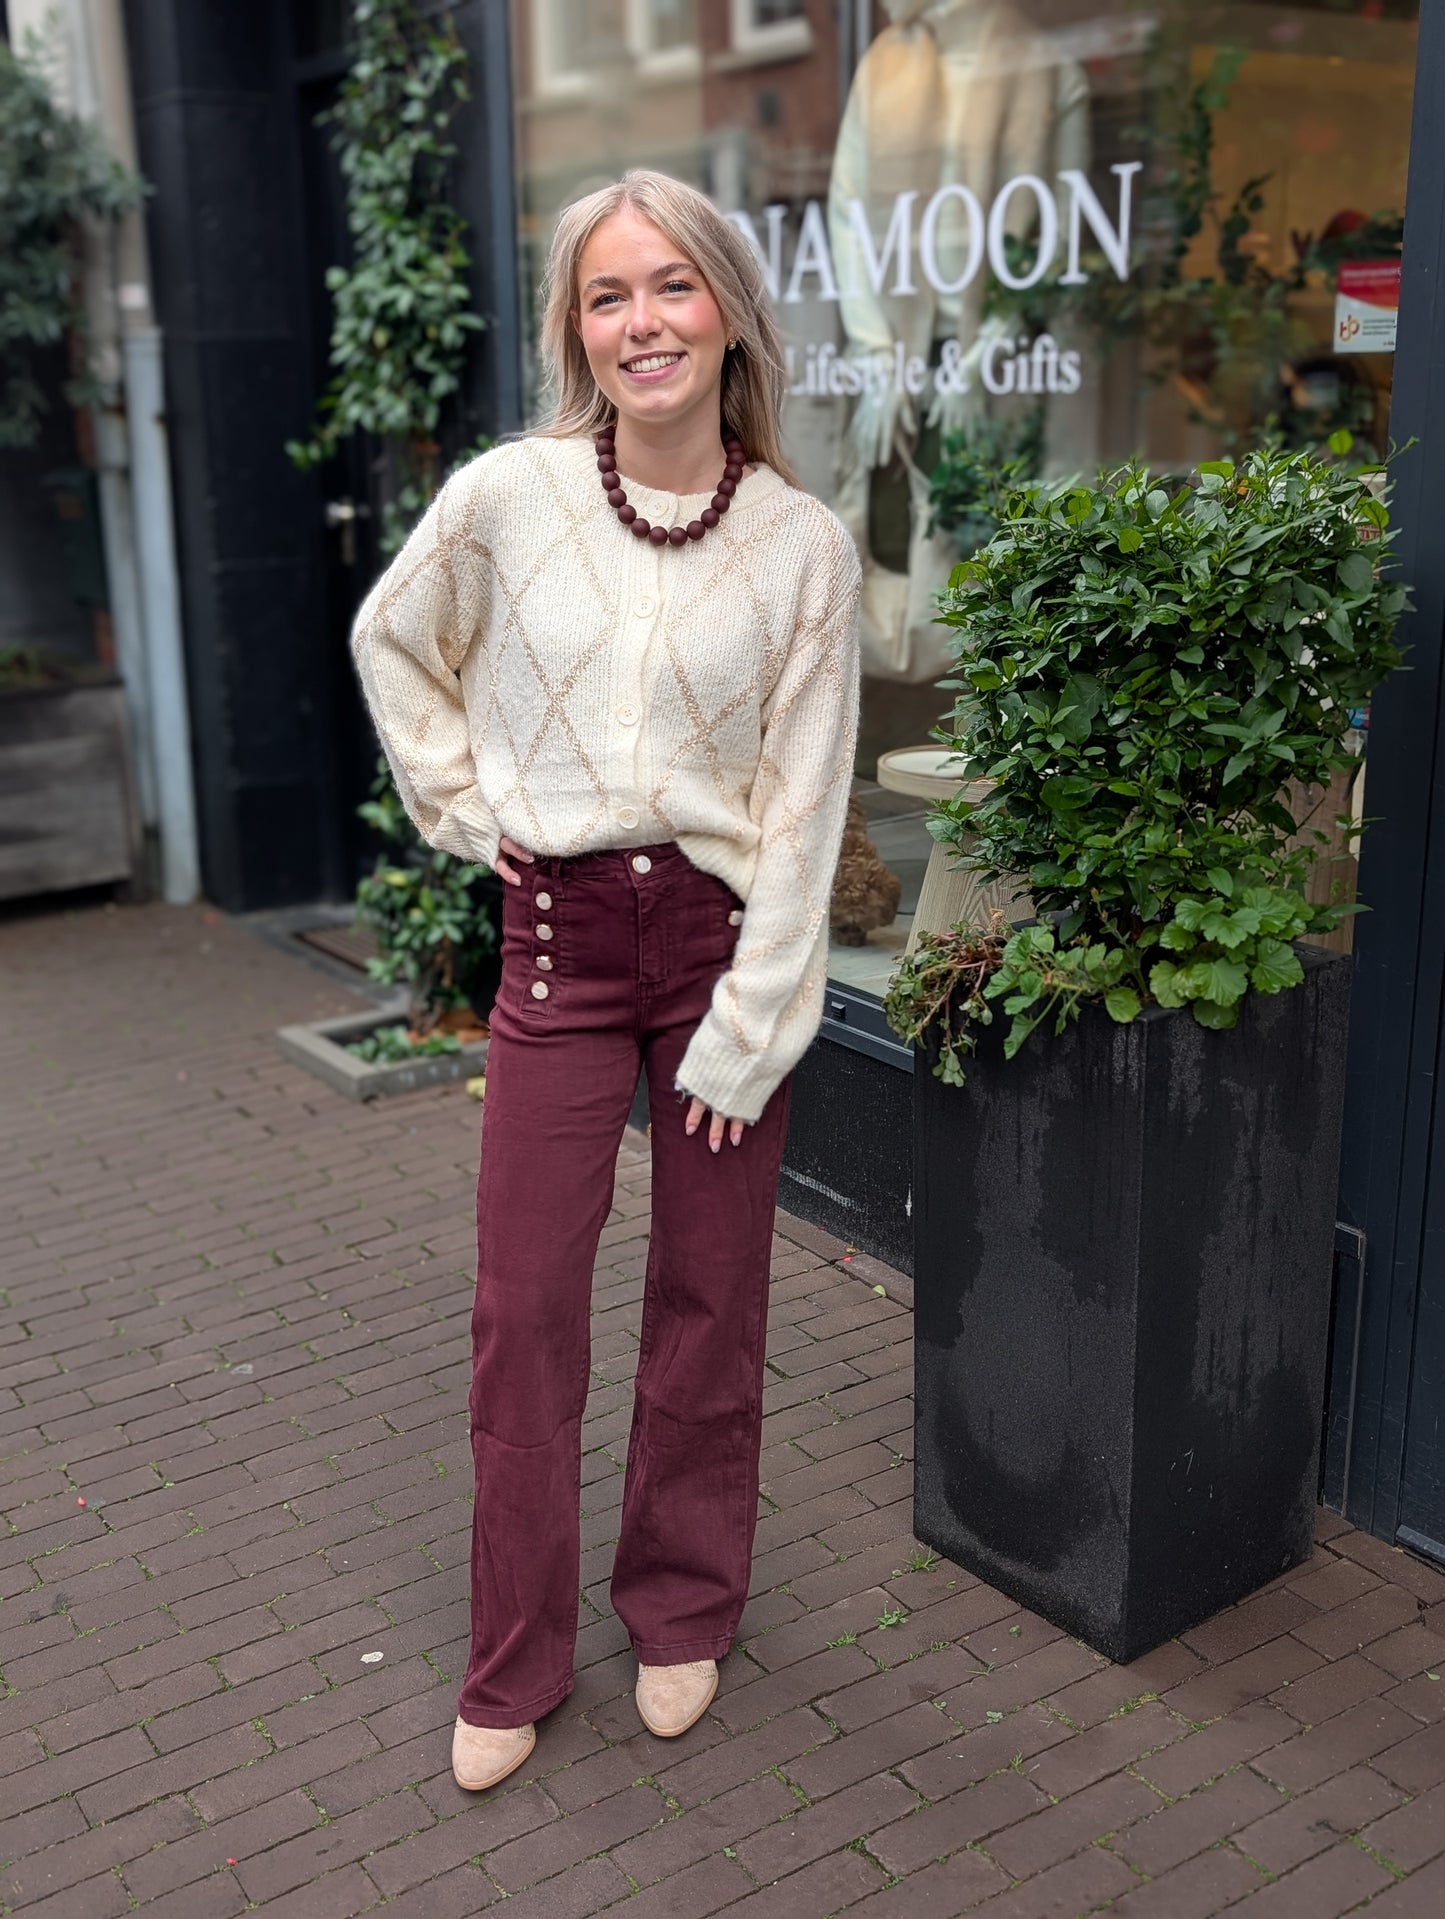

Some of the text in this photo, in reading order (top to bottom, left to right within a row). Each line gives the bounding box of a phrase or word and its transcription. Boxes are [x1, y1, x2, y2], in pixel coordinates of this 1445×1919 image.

[784, 333, 1082, 407] Lifestyle & Gifts
